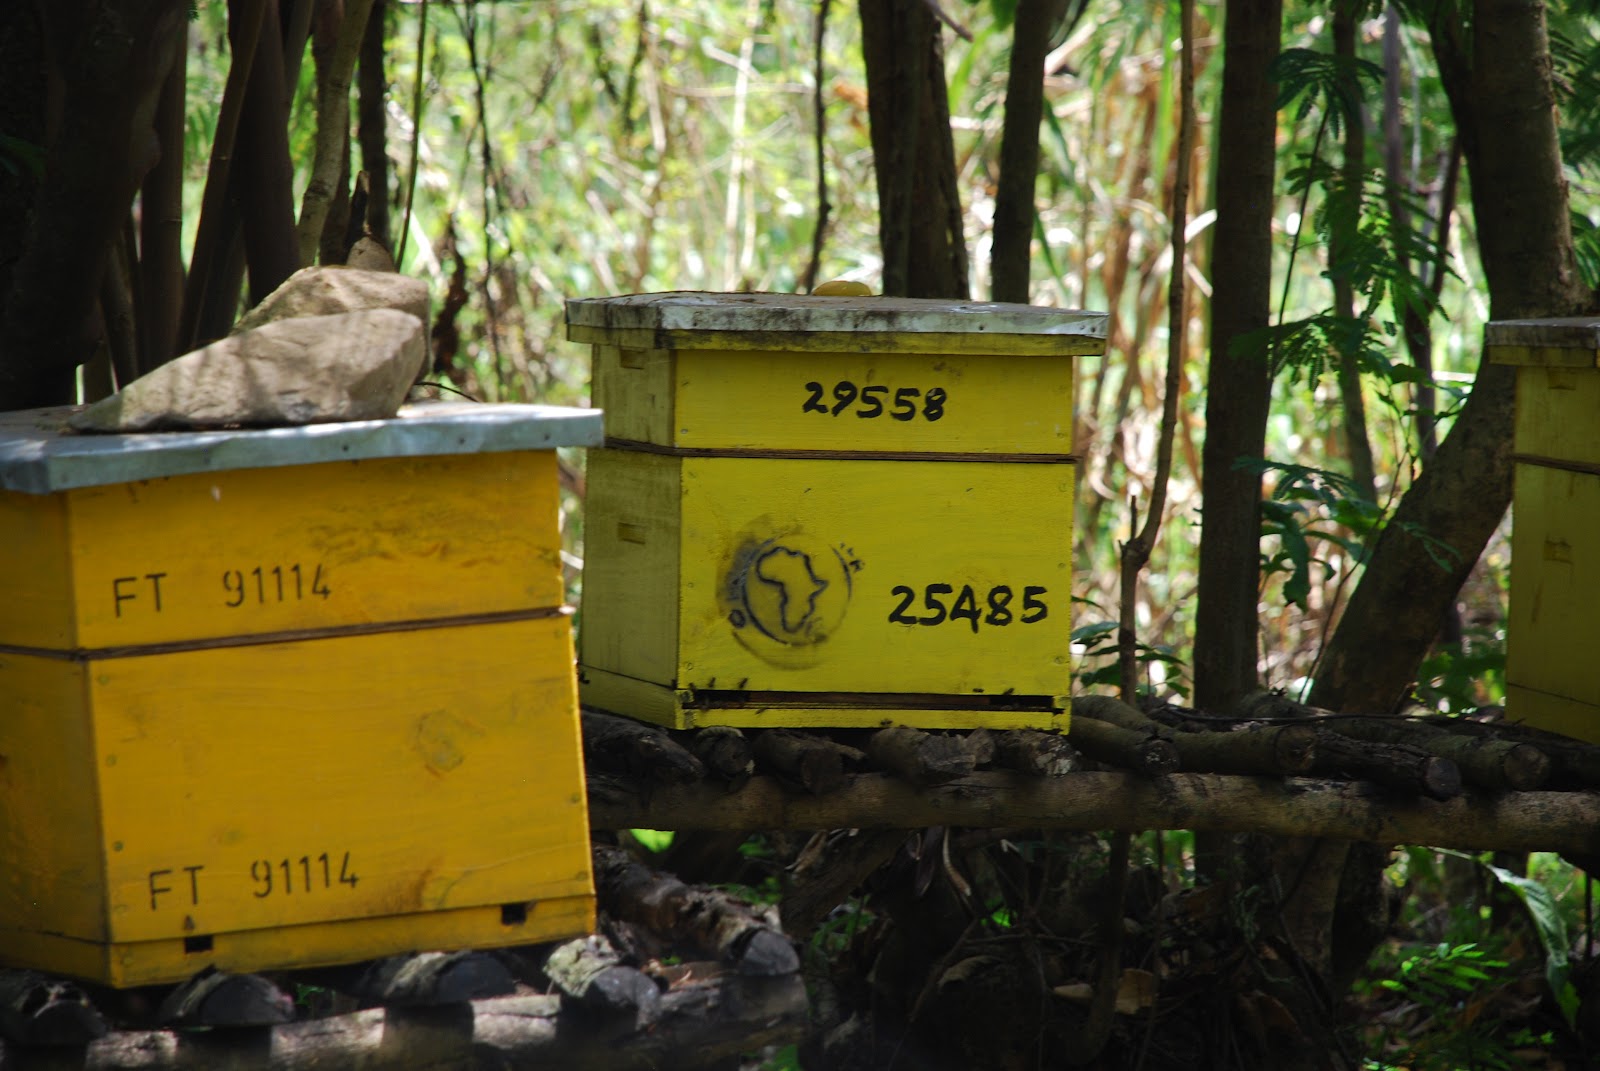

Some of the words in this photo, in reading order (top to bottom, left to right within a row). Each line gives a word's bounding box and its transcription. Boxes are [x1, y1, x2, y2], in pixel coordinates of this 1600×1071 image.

[802, 381, 948, 421] 29558
[112, 572, 168, 618] FT
[222, 563, 332, 608] 91114
[888, 583, 1048, 633] 25485
[148, 865, 204, 911] FT
[250, 851, 359, 898] 91114
